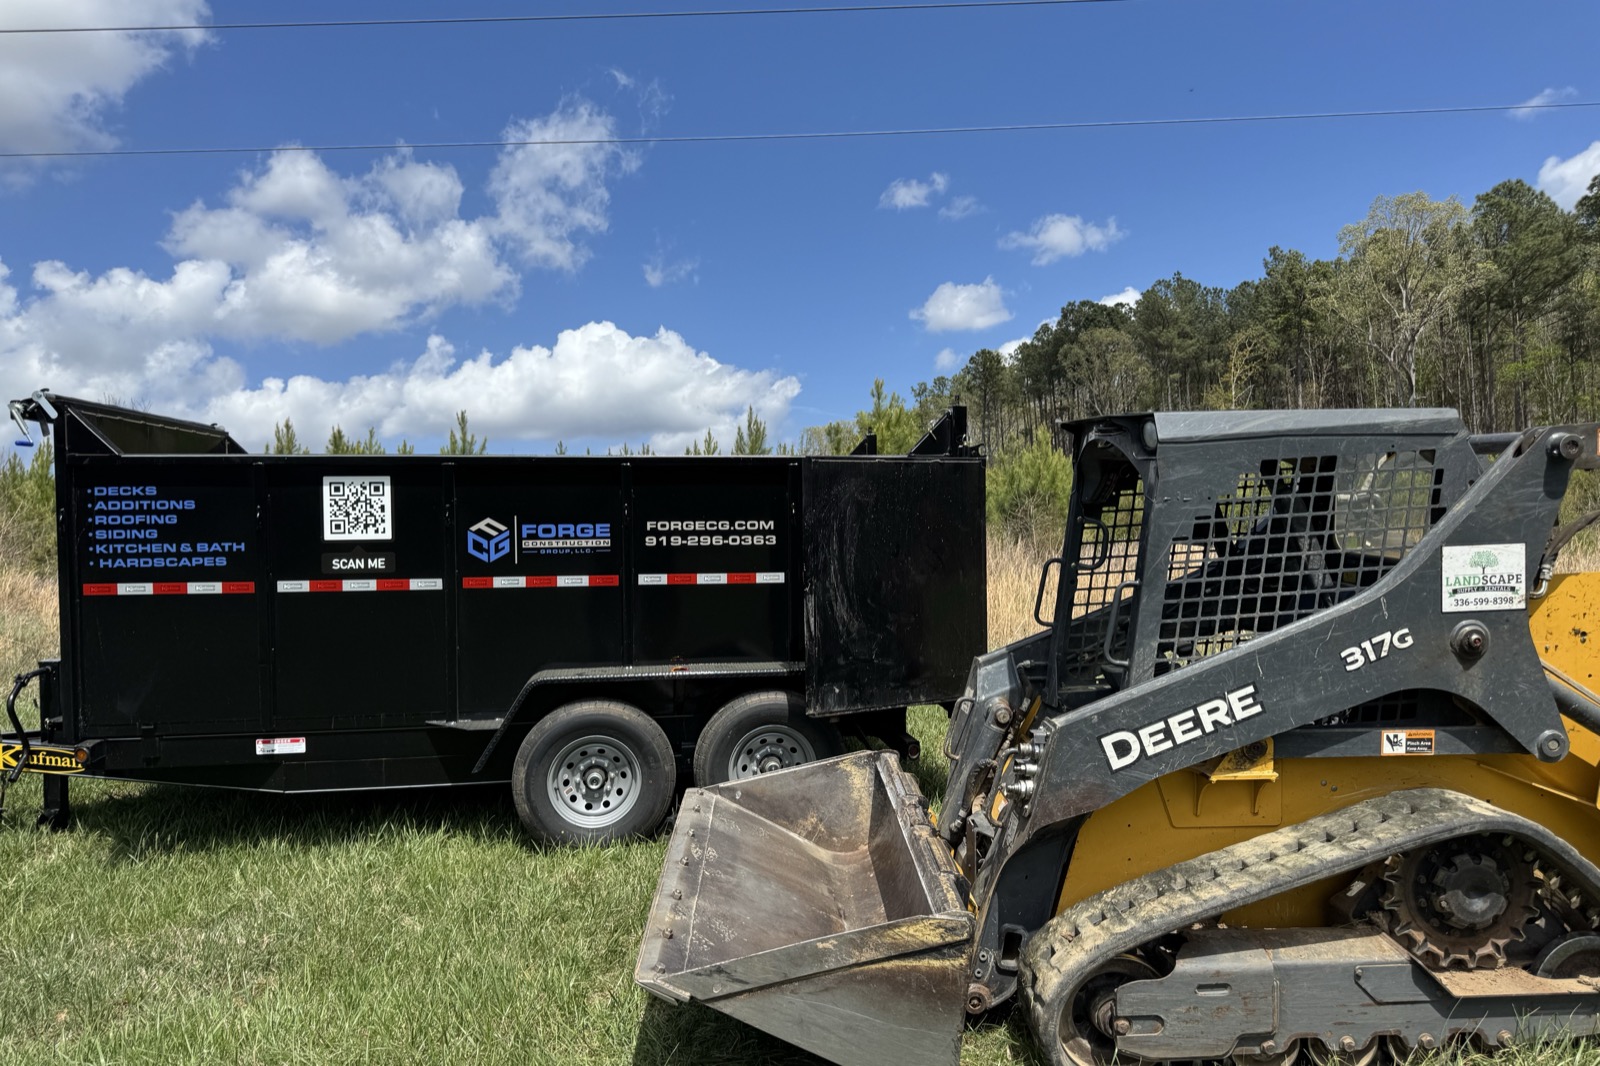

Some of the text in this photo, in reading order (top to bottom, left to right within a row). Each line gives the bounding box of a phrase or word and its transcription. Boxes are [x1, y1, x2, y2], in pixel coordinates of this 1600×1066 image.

[94, 486, 157, 496] DECKS
[94, 500, 196, 510] ADDITIONS
[94, 514, 178, 525] ROOFING
[646, 520, 775, 531] FORGECG.COM
[95, 529, 158, 539] SIDING
[521, 523, 611, 538] FORGE
[645, 535, 777, 546] 919-296-0363
[95, 542, 245, 554] KITCHEN & BATH
[99, 556, 228, 568] HARDSCAPES
[332, 558, 386, 570] SCAN ME
[1445, 573, 1522, 587] LANDSCAPE
[1454, 596, 1514, 607] 336-599-8398
[1340, 628, 1414, 671] 317G
[1101, 685, 1263, 771] DEERE
[0, 744, 83, 770] Kufman
